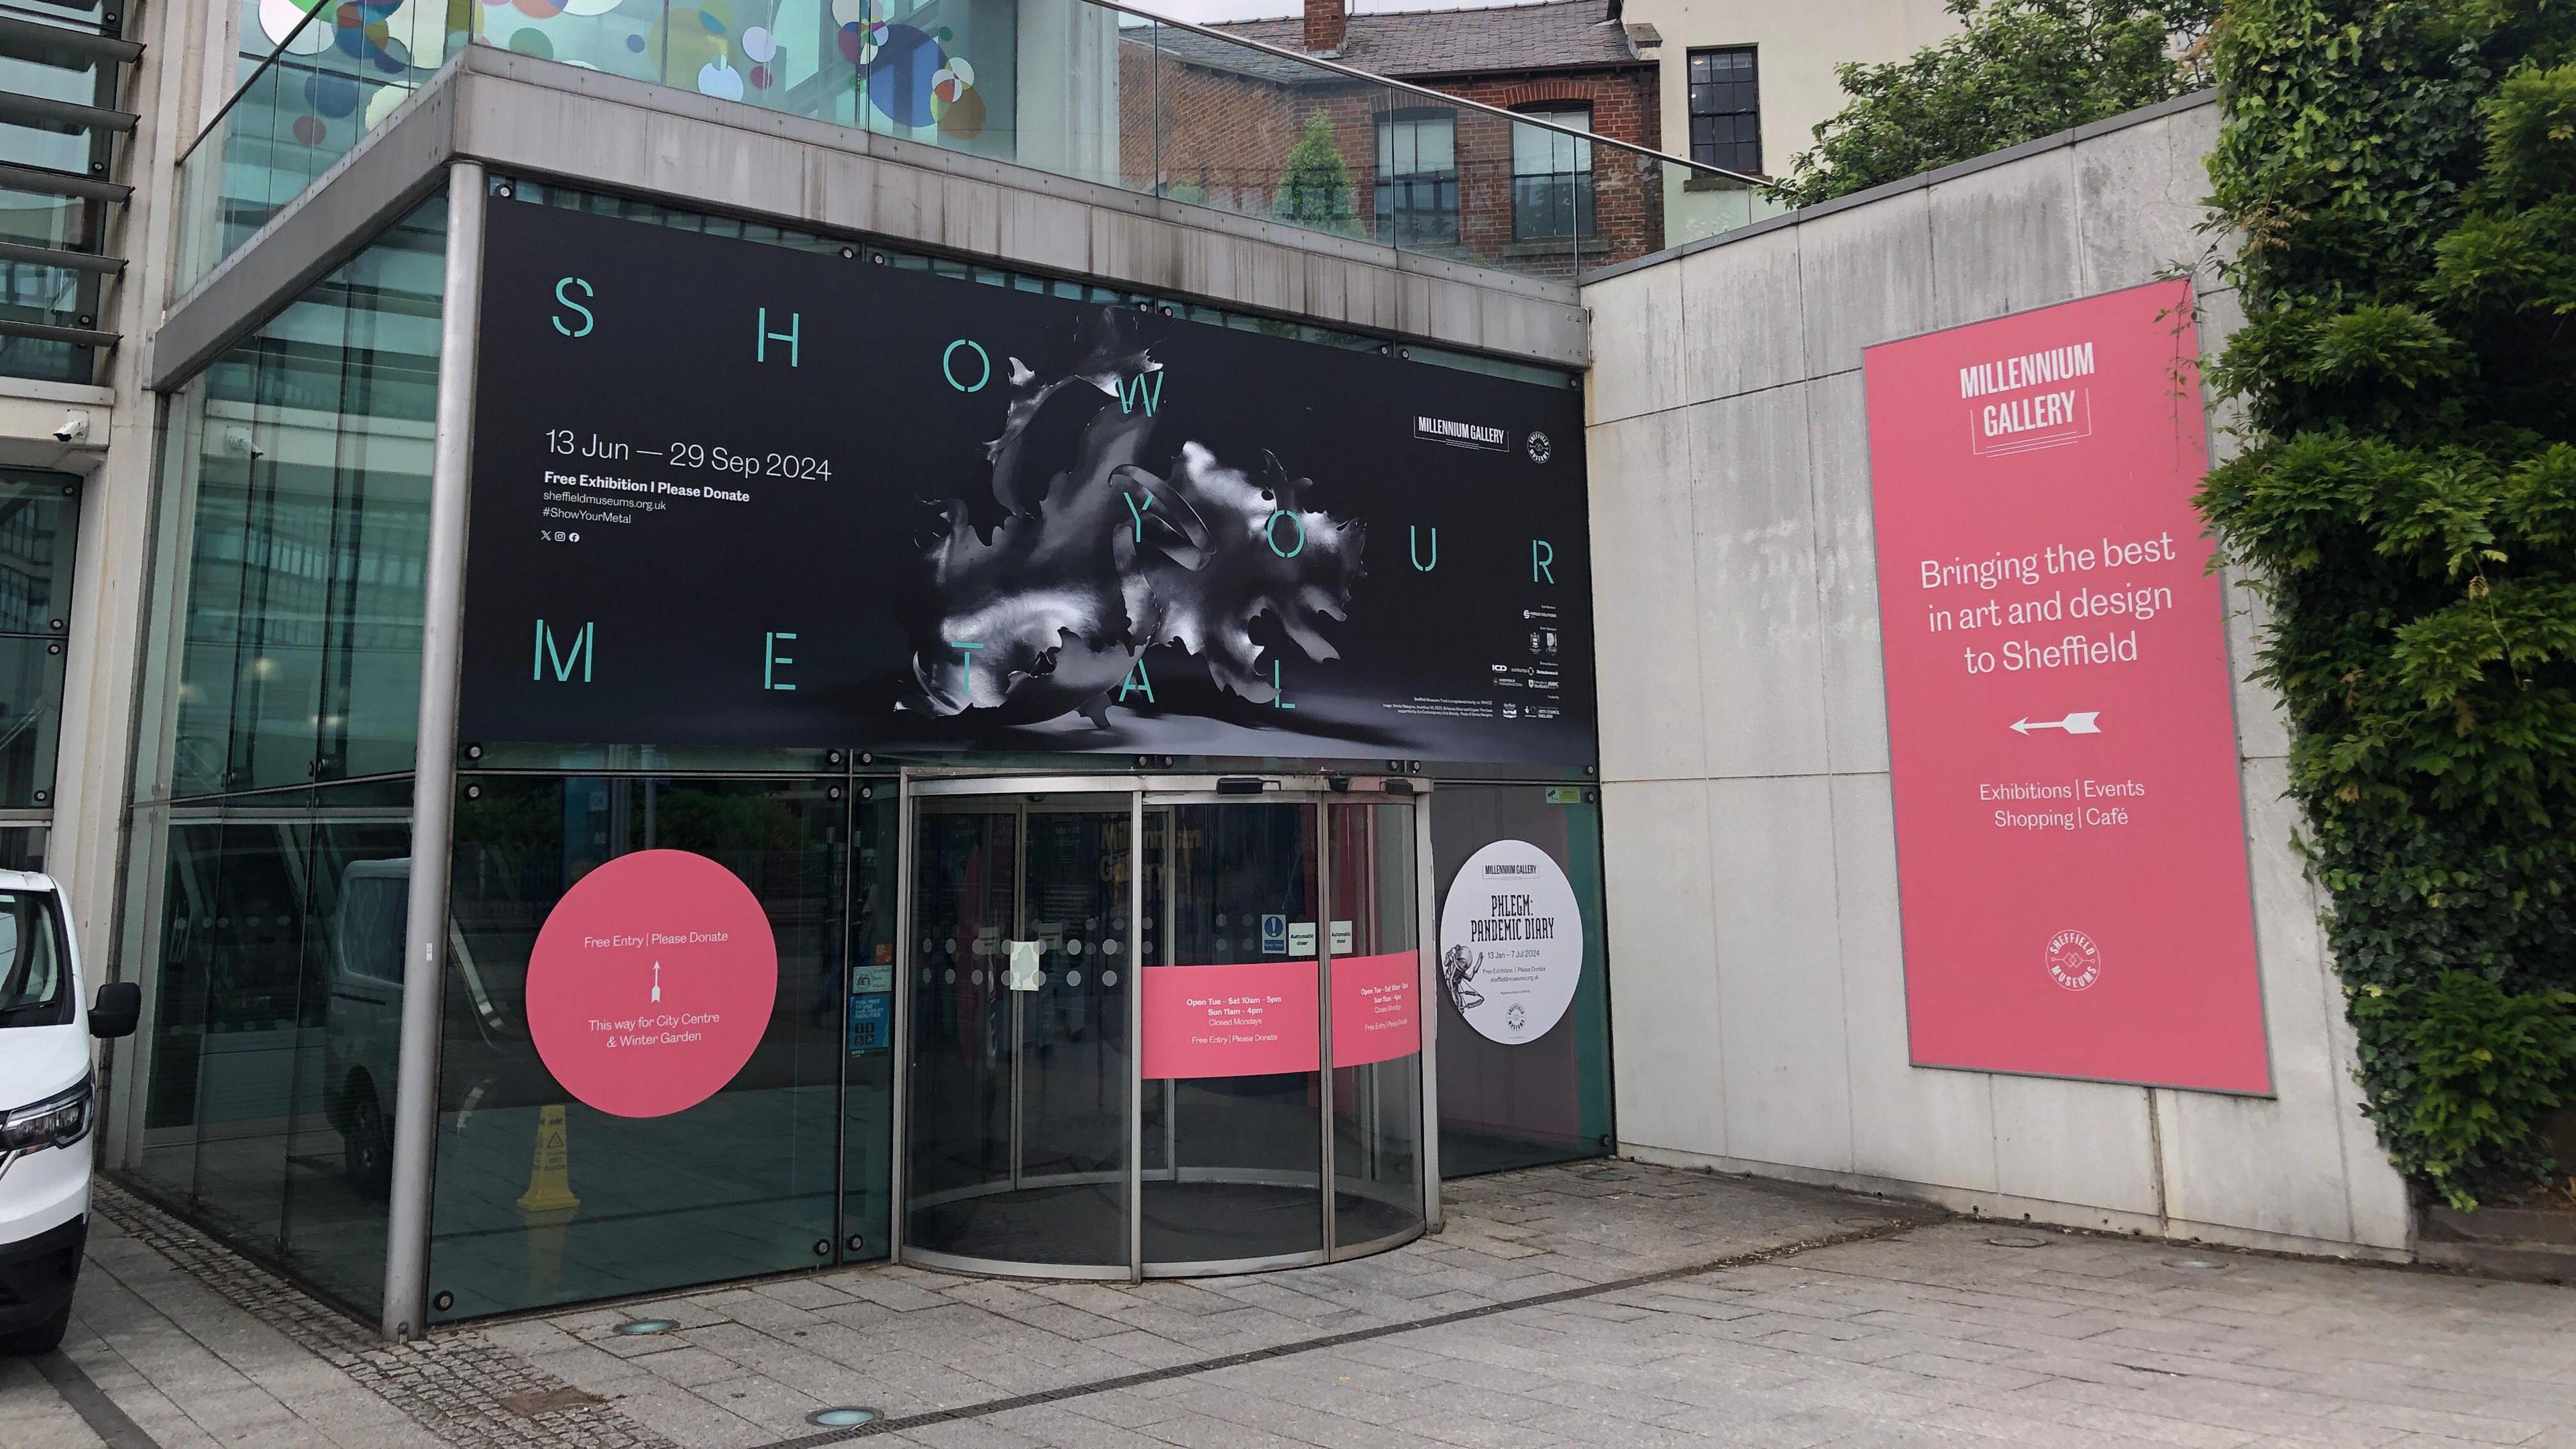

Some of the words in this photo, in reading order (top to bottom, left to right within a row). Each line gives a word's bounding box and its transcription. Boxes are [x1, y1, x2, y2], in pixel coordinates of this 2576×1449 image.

[1960, 341, 2095, 399] MILLENNIUM
[1983, 390, 2076, 437] GALLERY
[1418, 416, 1469, 439] MILLENNIUM
[1470, 425, 1504, 444] GALLERY
[545, 429, 575, 454] 13
[582, 435, 629, 461] Jun
[669, 442, 704, 468] 29
[711, 448, 759, 478] Sep
[766, 453, 832, 482] 2024
[544, 472, 577, 486] Free
[580, 474, 648, 493] Exhibition
[657, 482, 701, 497] Please
[704, 486, 750, 502] Donate
[543, 490, 666, 513] sheffieldmuseums.org.uk
[543, 506, 631, 524] #ShowYourMetal
[1921, 551, 2039, 590] Bringing
[2045, 543, 2096, 574] the
[2103, 531, 2176, 568] best
[1929, 604, 1952, 633] in
[1959, 598, 2002, 630] art
[2008, 591, 2062, 625] and
[2070, 582, 2173, 621] design
[1964, 646, 1995, 675] to
[2002, 630, 2138, 672] Sheffield
[1980, 782, 2072, 801] Exhibitions
[2084, 780, 2145, 798] Events
[1994, 809, 2074, 830] Shopping
[2086, 807, 2129, 826] Café
[1485, 864, 1515, 875] MILLENNIUM
[1516, 864, 1537, 874] GALLERY
[1491, 894, 1534, 917] PHLEGM:
[584, 936, 610, 948] Free
[613, 935, 644, 948] Entry
[651, 933, 687, 945] Please
[690, 931, 729, 943] Donate
[1471, 919, 1521, 943] PANDEMIC
[1523, 918, 1554, 940] DIARY
[2049, 932, 2096, 956] SHEFFIELD
[2051, 965, 2098, 989] MUSEUMS
[1186, 998, 1207, 1008] Open
[1208, 998, 1222, 1006] Tue
[1267, 996, 1282, 1005] 5pm
[1208, 1008, 1222, 1016] Sun
[1246, 1007, 1263, 1016] 4pm
[588, 1019, 612, 1031] This
[614, 1021, 635, 1032] way
[638, 1016, 654, 1028] for
[657, 1015, 679, 1027] City
[682, 1013, 720, 1025] Centre
[1209, 1018, 1232, 1026] Closed
[1234, 1018, 1262, 1026] Mondays
[606, 1037, 617, 1048] &
[620, 1035, 658, 1046] Winter
[661, 1032, 702, 1044] Garden
[1209, 1036, 1228, 1044] Entry
[1232, 1034, 1253, 1042] Please
[1254, 1034, 1278, 1042] Donate
